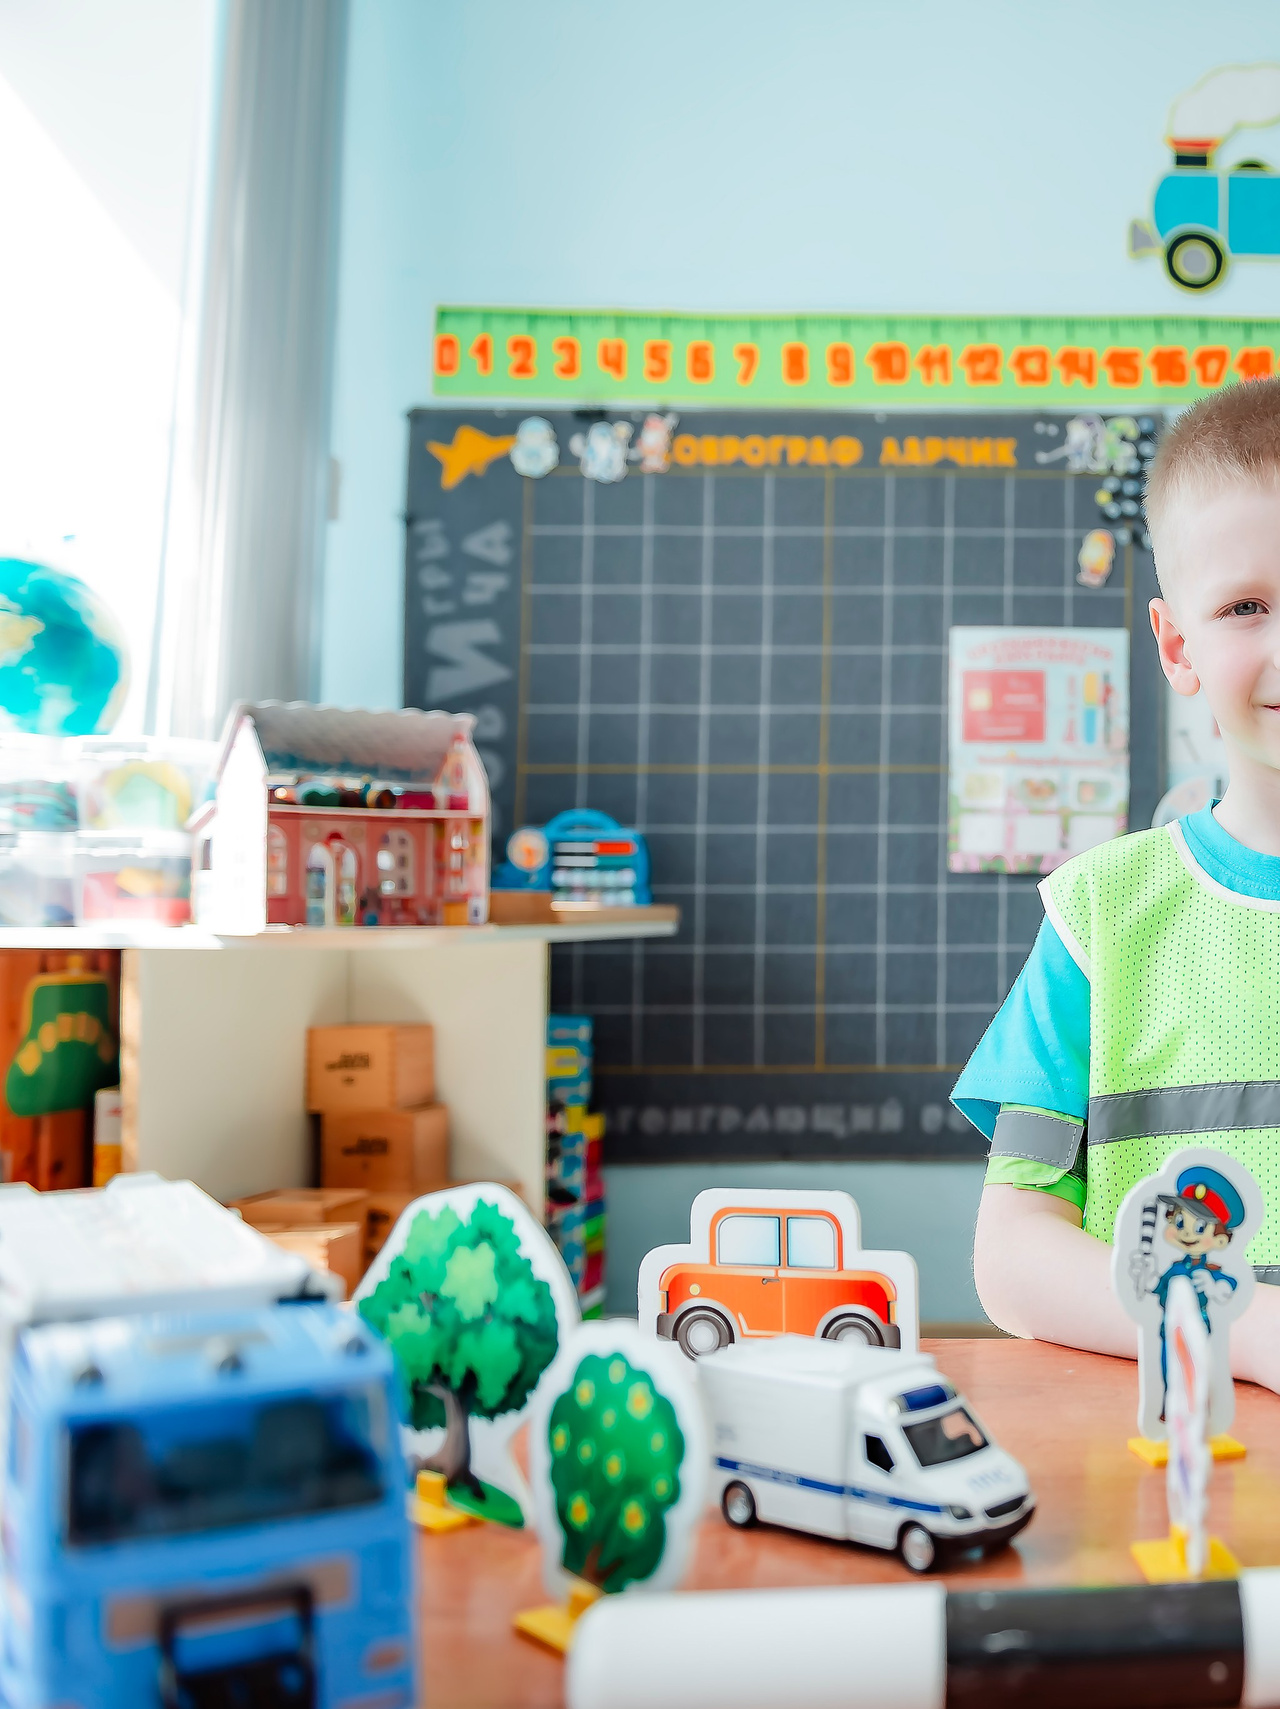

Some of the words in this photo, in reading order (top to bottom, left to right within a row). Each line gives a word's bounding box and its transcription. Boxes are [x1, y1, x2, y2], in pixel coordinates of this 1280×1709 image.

[434, 333, 459, 377] 0
[468, 332, 494, 376] 1
[506, 335, 537, 379] 2
[552, 336, 581, 380] 3
[598, 337, 628, 382] 4
[644, 339, 672, 384] 5
[687, 340, 715, 384] 6
[733, 342, 760, 387] 7
[782, 341, 809, 386] 8
[826, 342, 855, 386] 9
[864, 341, 910, 385] 10
[913, 343, 952, 386] 11
[958, 343, 1003, 386] 12
[1007, 344, 1051, 386] 13
[1052, 345, 1097, 389] 14
[1101, 346, 1144, 388] 15
[1146, 345, 1190, 387] 16
[1190, 345, 1231, 387] 17
[667, 433, 864, 468] ОВРОГРАФ
[607, 1098, 904, 1139] ГОИГРАЮЩИЙ
